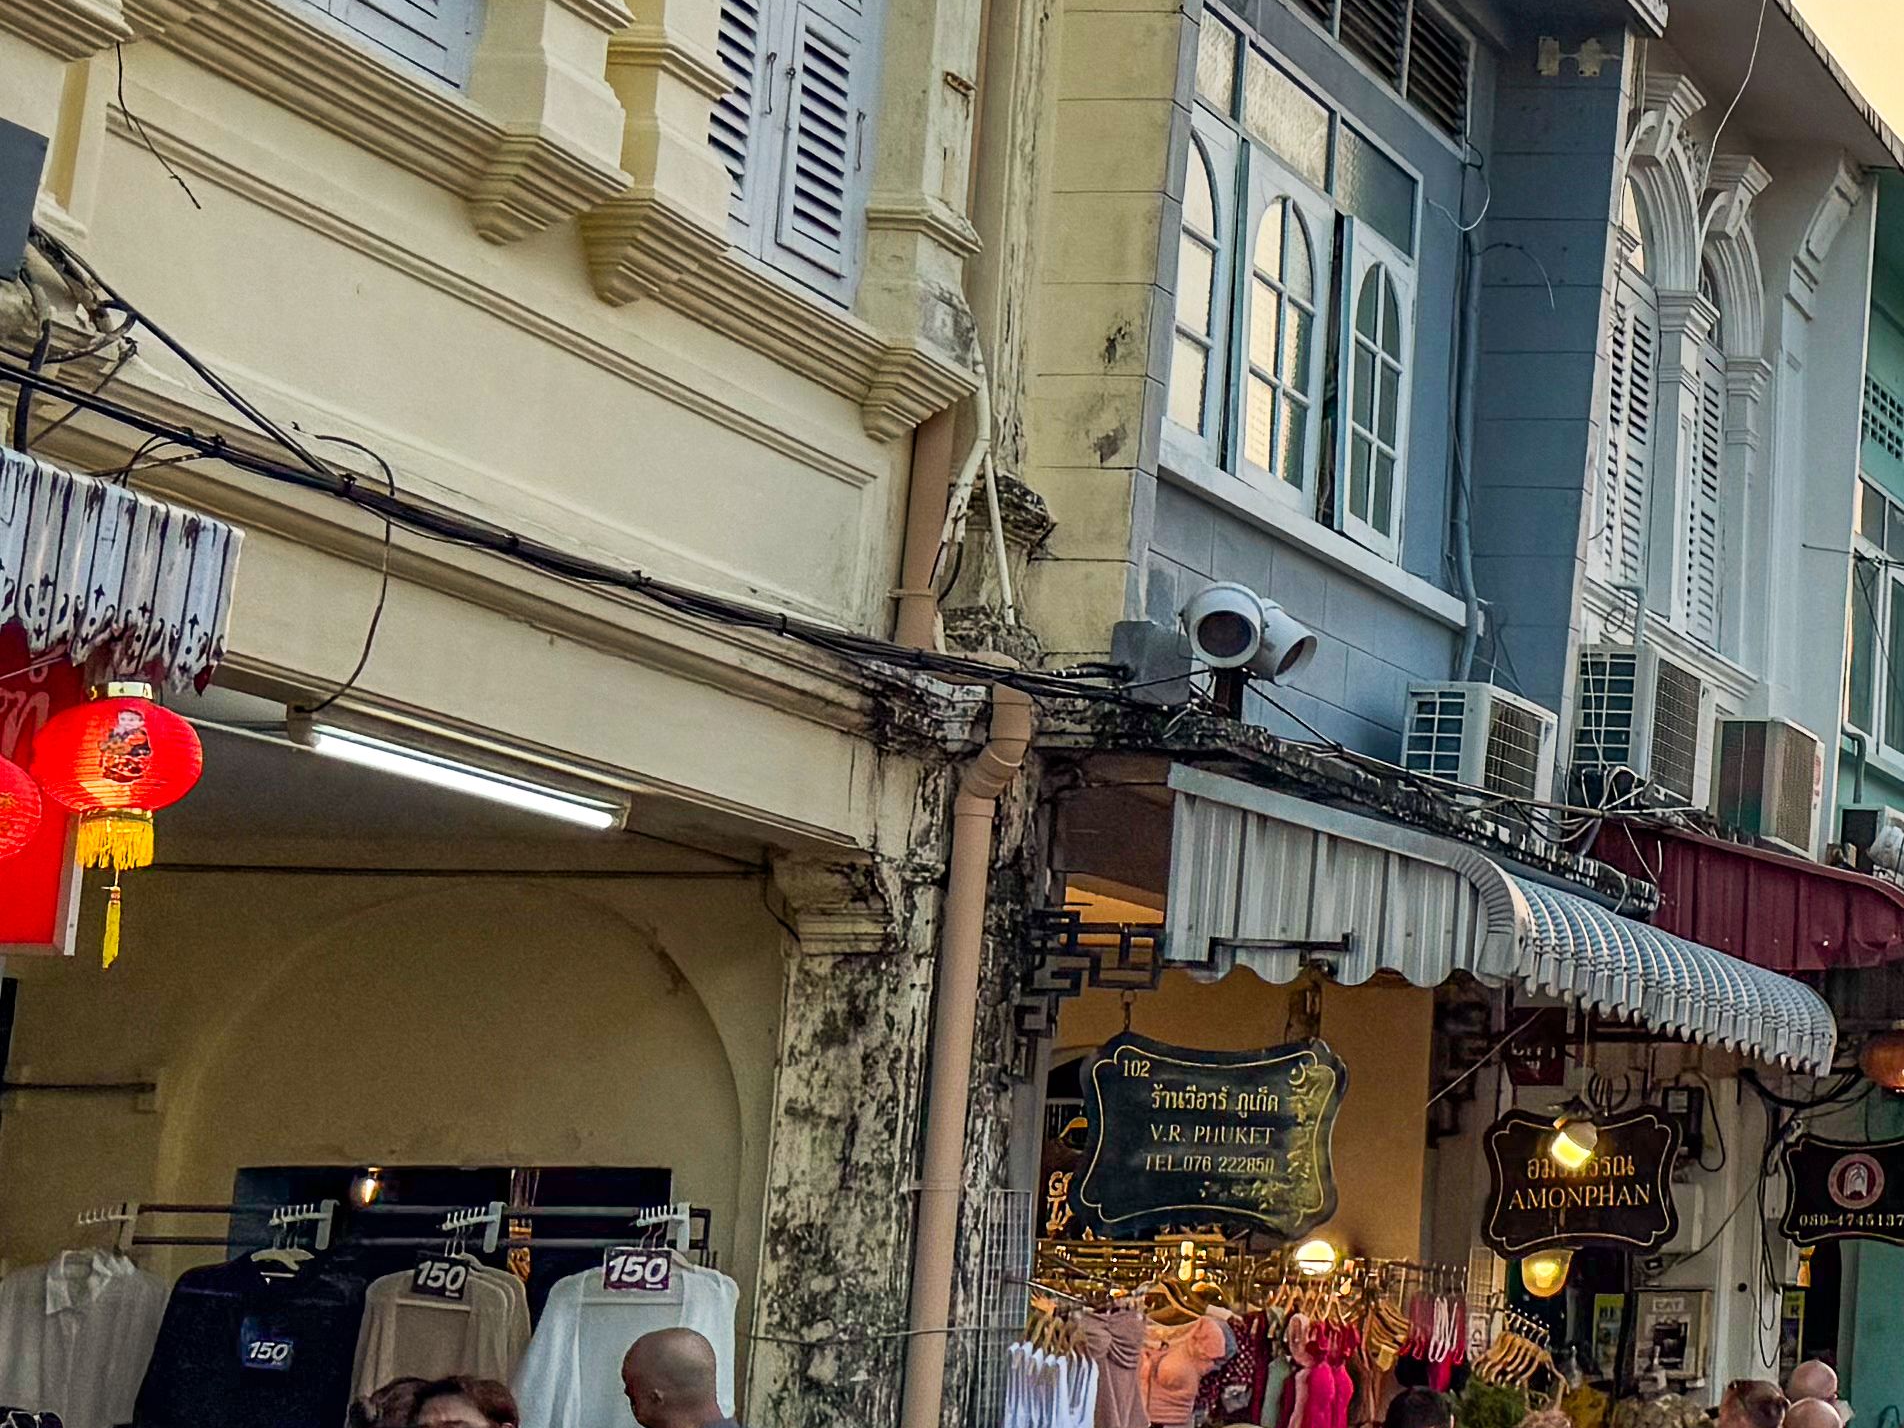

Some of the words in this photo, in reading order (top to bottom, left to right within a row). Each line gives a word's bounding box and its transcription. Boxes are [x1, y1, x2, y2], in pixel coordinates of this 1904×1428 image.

[1122, 1059, 1151, 1077] 102
[1150, 1123, 1186, 1143] V.R.
[1193, 1125, 1276, 1145] PHUKET
[1508, 1181, 1651, 1211] AMONPHAN
[416, 1259, 466, 1294] 150
[606, 1255, 669, 1284] 150
[247, 1340, 289, 1361] 150
